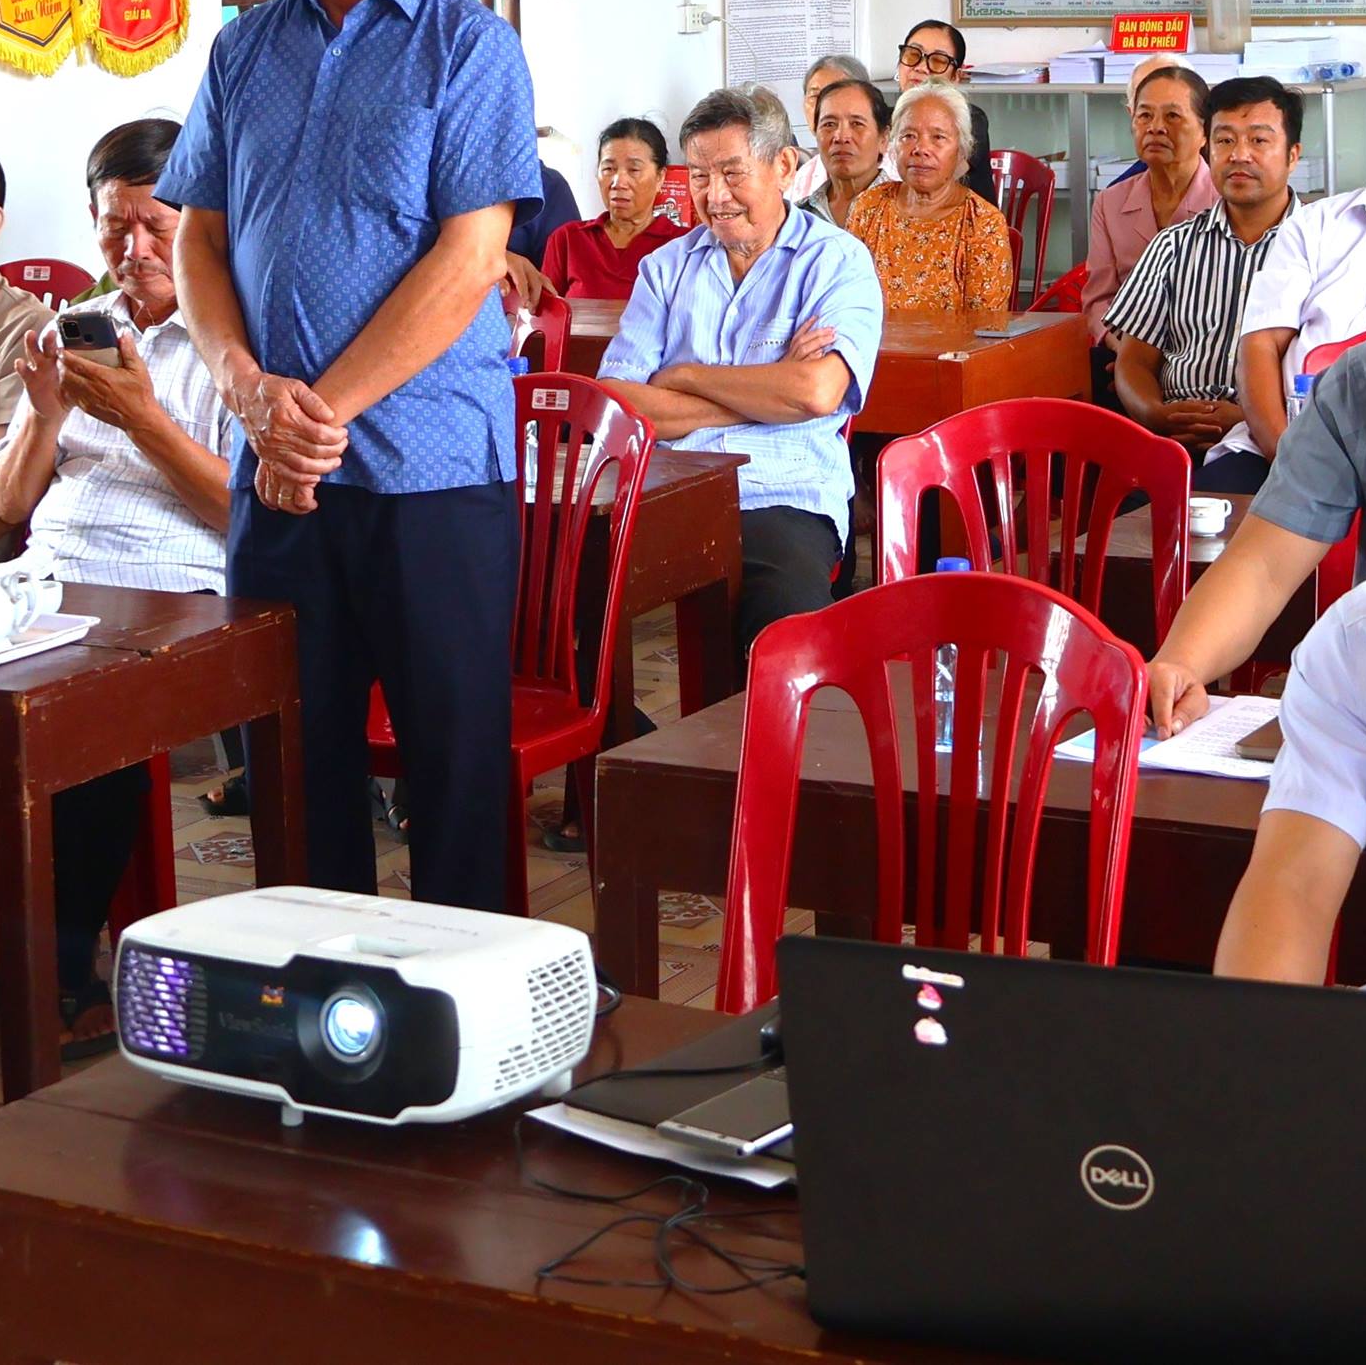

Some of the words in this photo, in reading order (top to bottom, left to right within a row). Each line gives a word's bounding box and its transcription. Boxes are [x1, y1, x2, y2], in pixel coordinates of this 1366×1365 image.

[14, 5, 34, 25] Lưu
[124, 6, 140, 21] GIẢI
[140, 8, 153, 20] BA
[1118, 18, 1138, 33] BÀN
[1138, 18, 1164, 33] ĐÓNG
[1136, 32, 1149, 48] BỎ
[1150, 33, 1177, 48] PHIẾU
[1090, 1165, 1147, 1189] DELL
